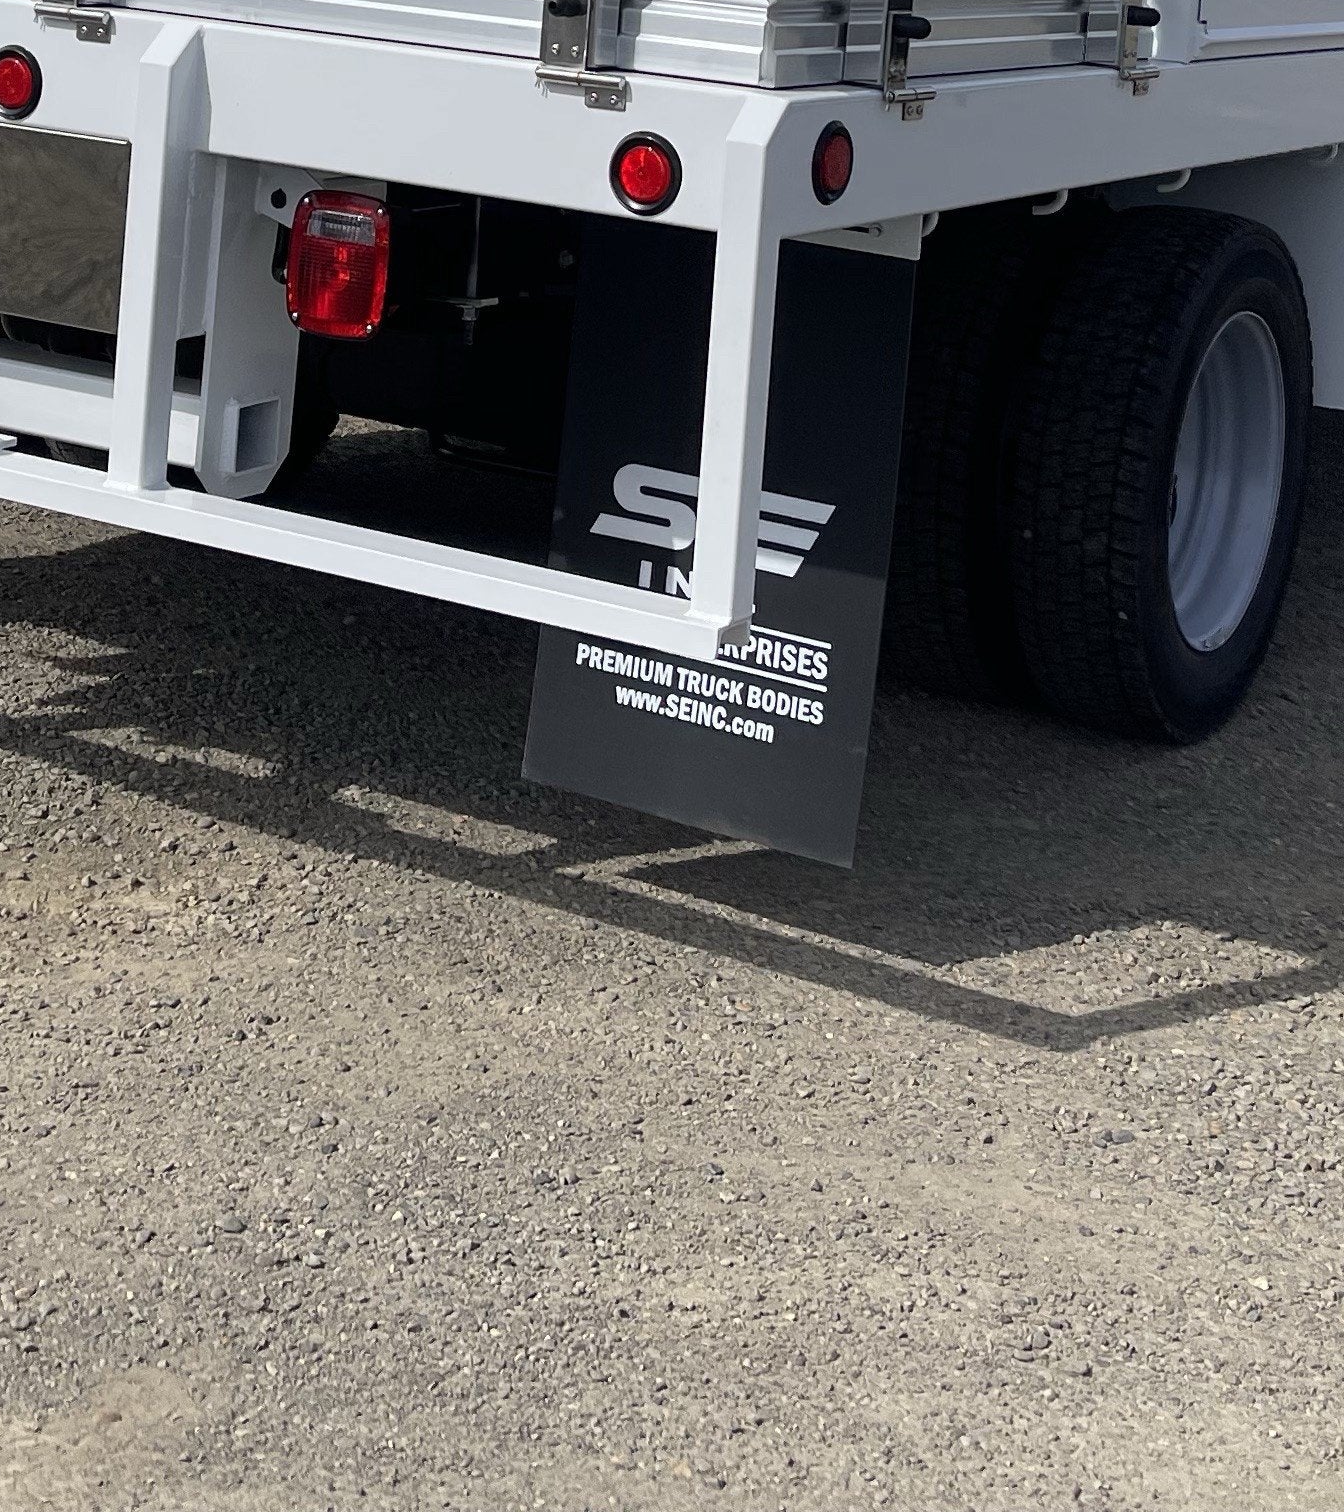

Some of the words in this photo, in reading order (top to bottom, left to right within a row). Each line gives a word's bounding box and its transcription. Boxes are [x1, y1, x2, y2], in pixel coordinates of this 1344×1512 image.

[575, 642, 674, 688] PREMIUM
[676, 666, 745, 705] TRUCK
[746, 684, 824, 725] BODIES
[615, 685, 775, 744] www.SEINC.com
